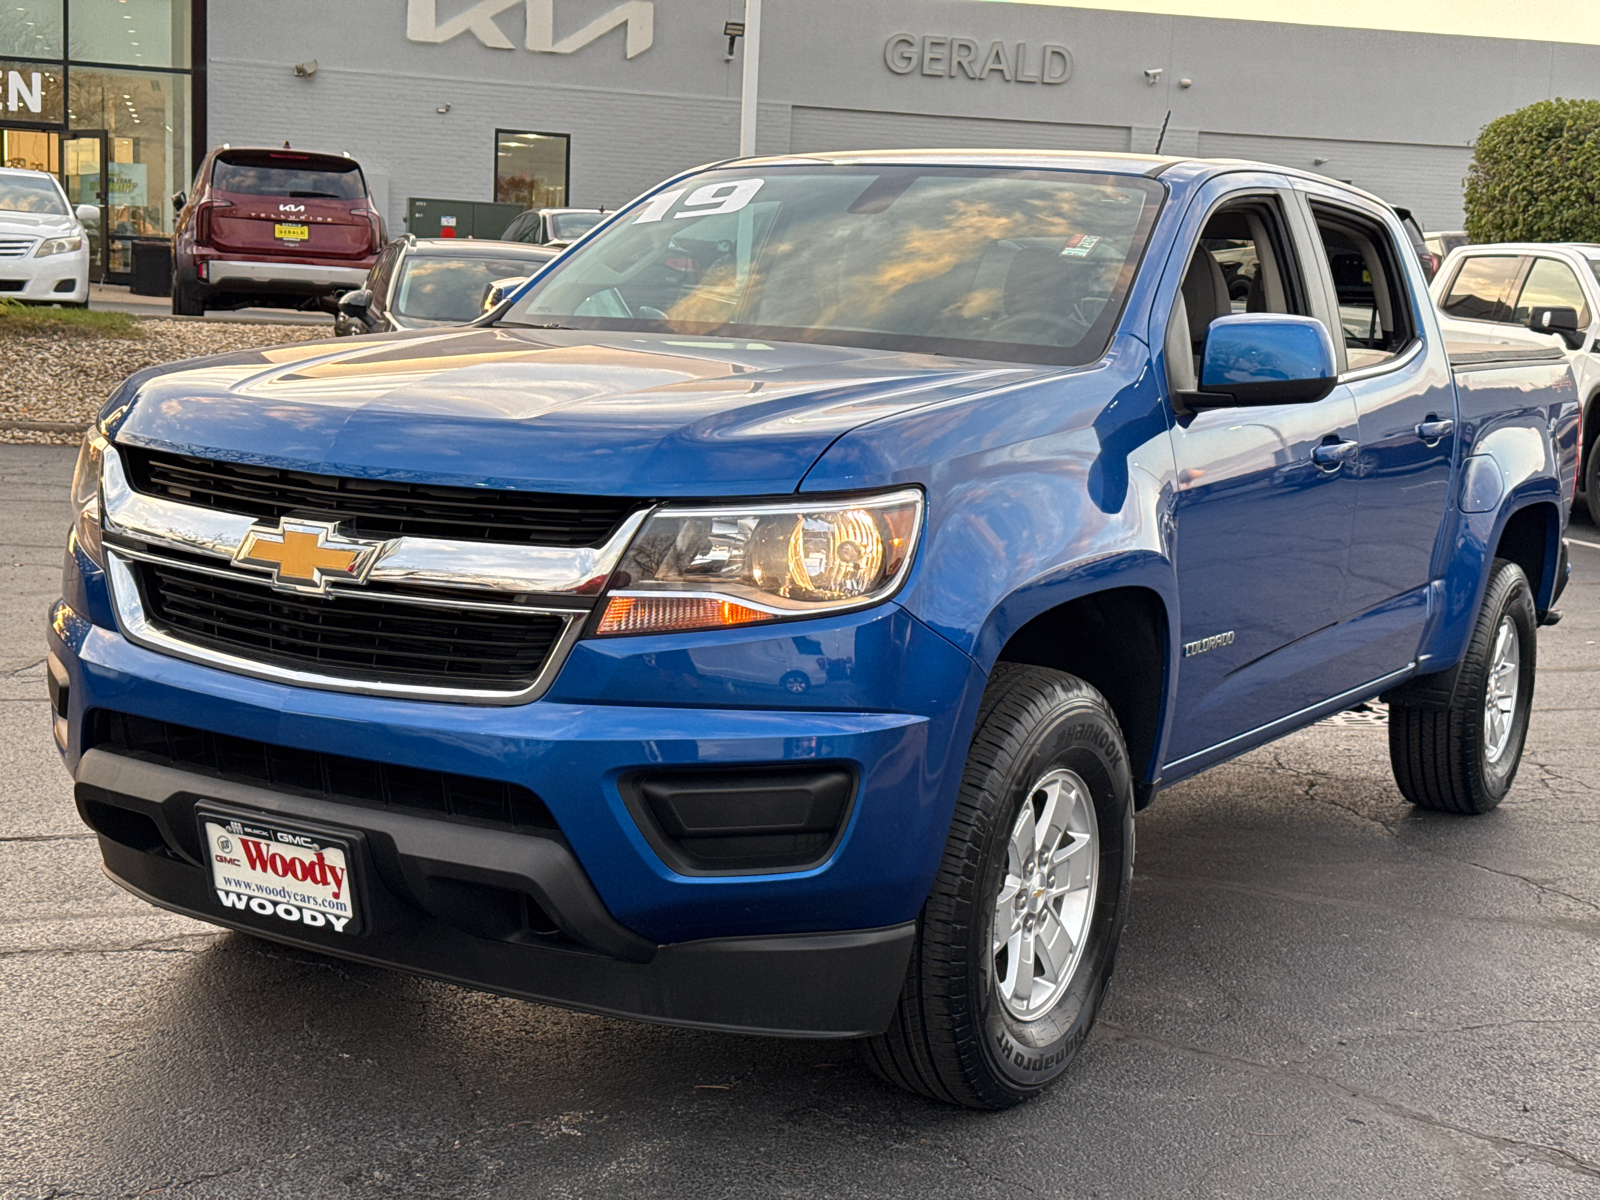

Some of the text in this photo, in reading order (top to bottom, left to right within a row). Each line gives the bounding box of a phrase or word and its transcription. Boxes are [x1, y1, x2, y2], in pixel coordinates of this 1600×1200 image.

[884, 32, 1074, 85] GERALD
[0, 69, 42, 113] N
[631, 178, 765, 225] 19
[1185, 630, 1235, 658] COLORADO
[243, 827, 315, 849] BUICK GMC
[214, 854, 241, 867] GMC
[237, 836, 345, 900] Woody
[216, 889, 350, 933] WOODY
[222, 875, 348, 912] www.woodycars.com
